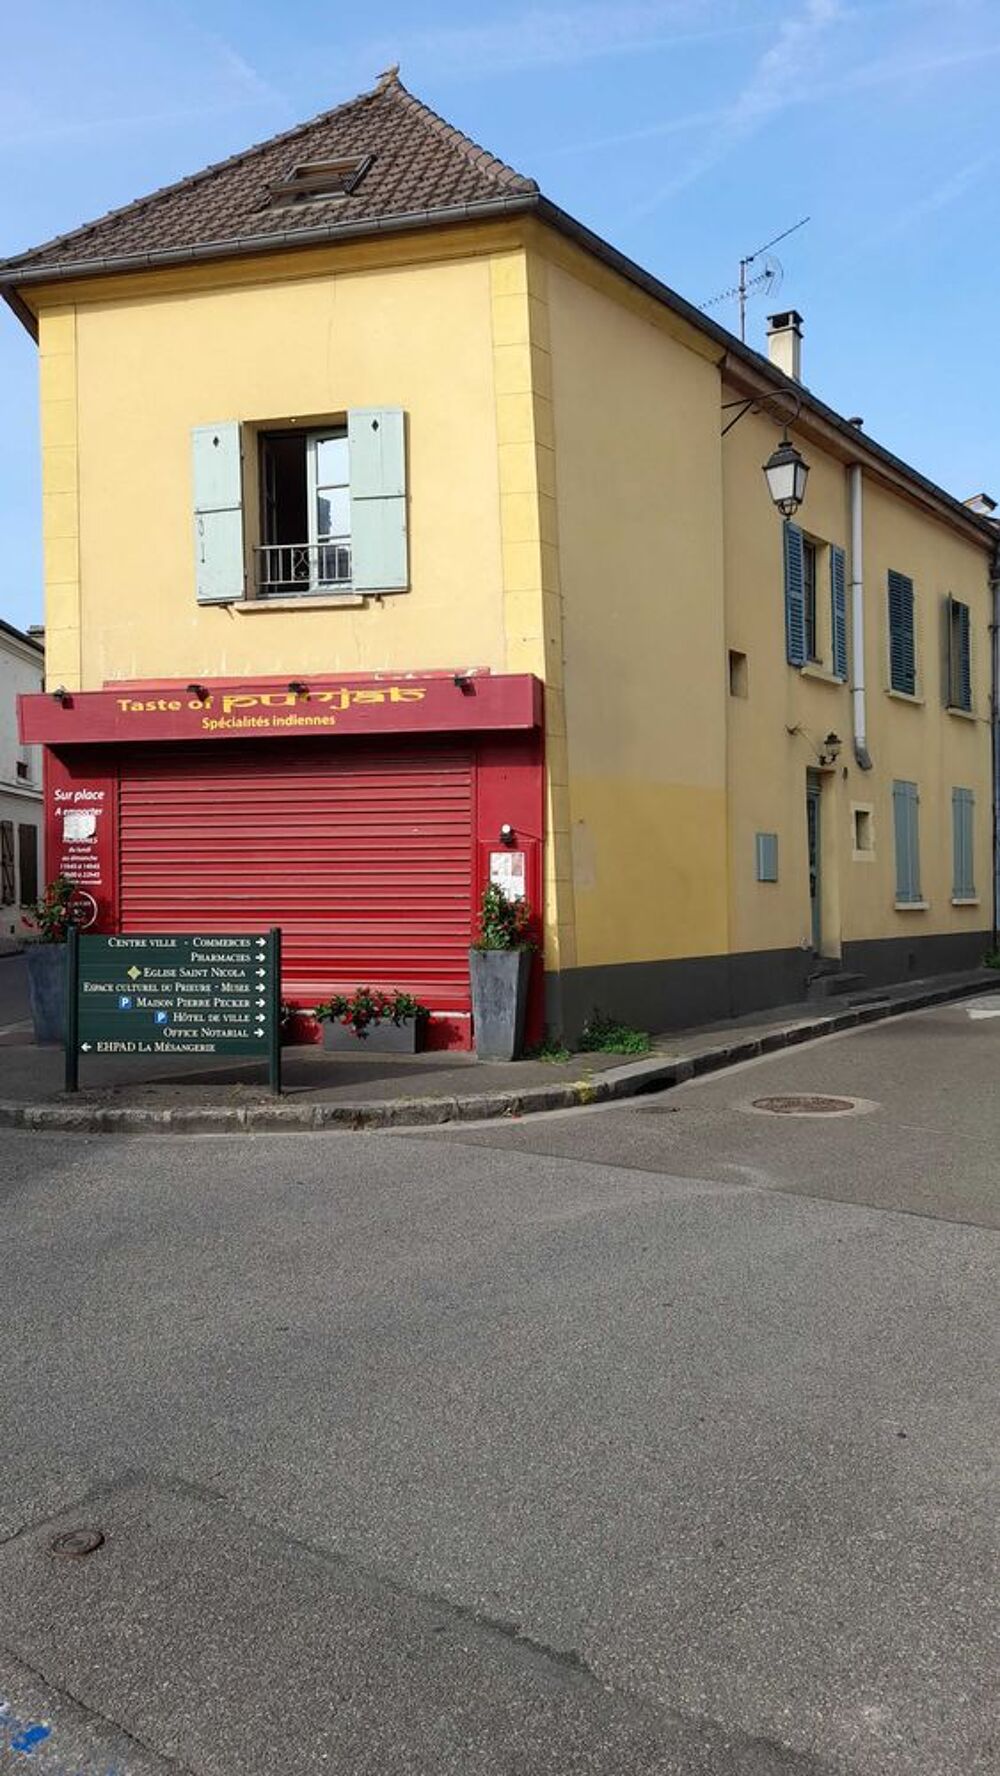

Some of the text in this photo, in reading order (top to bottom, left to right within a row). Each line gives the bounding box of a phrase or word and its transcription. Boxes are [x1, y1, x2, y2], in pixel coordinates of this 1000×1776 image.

[116, 698, 182, 712] Taste
[202, 713, 335, 731] Spécialités indiennes
[54, 788, 105, 803] Sur place
[96, 1041, 136, 1052] EHPAD
